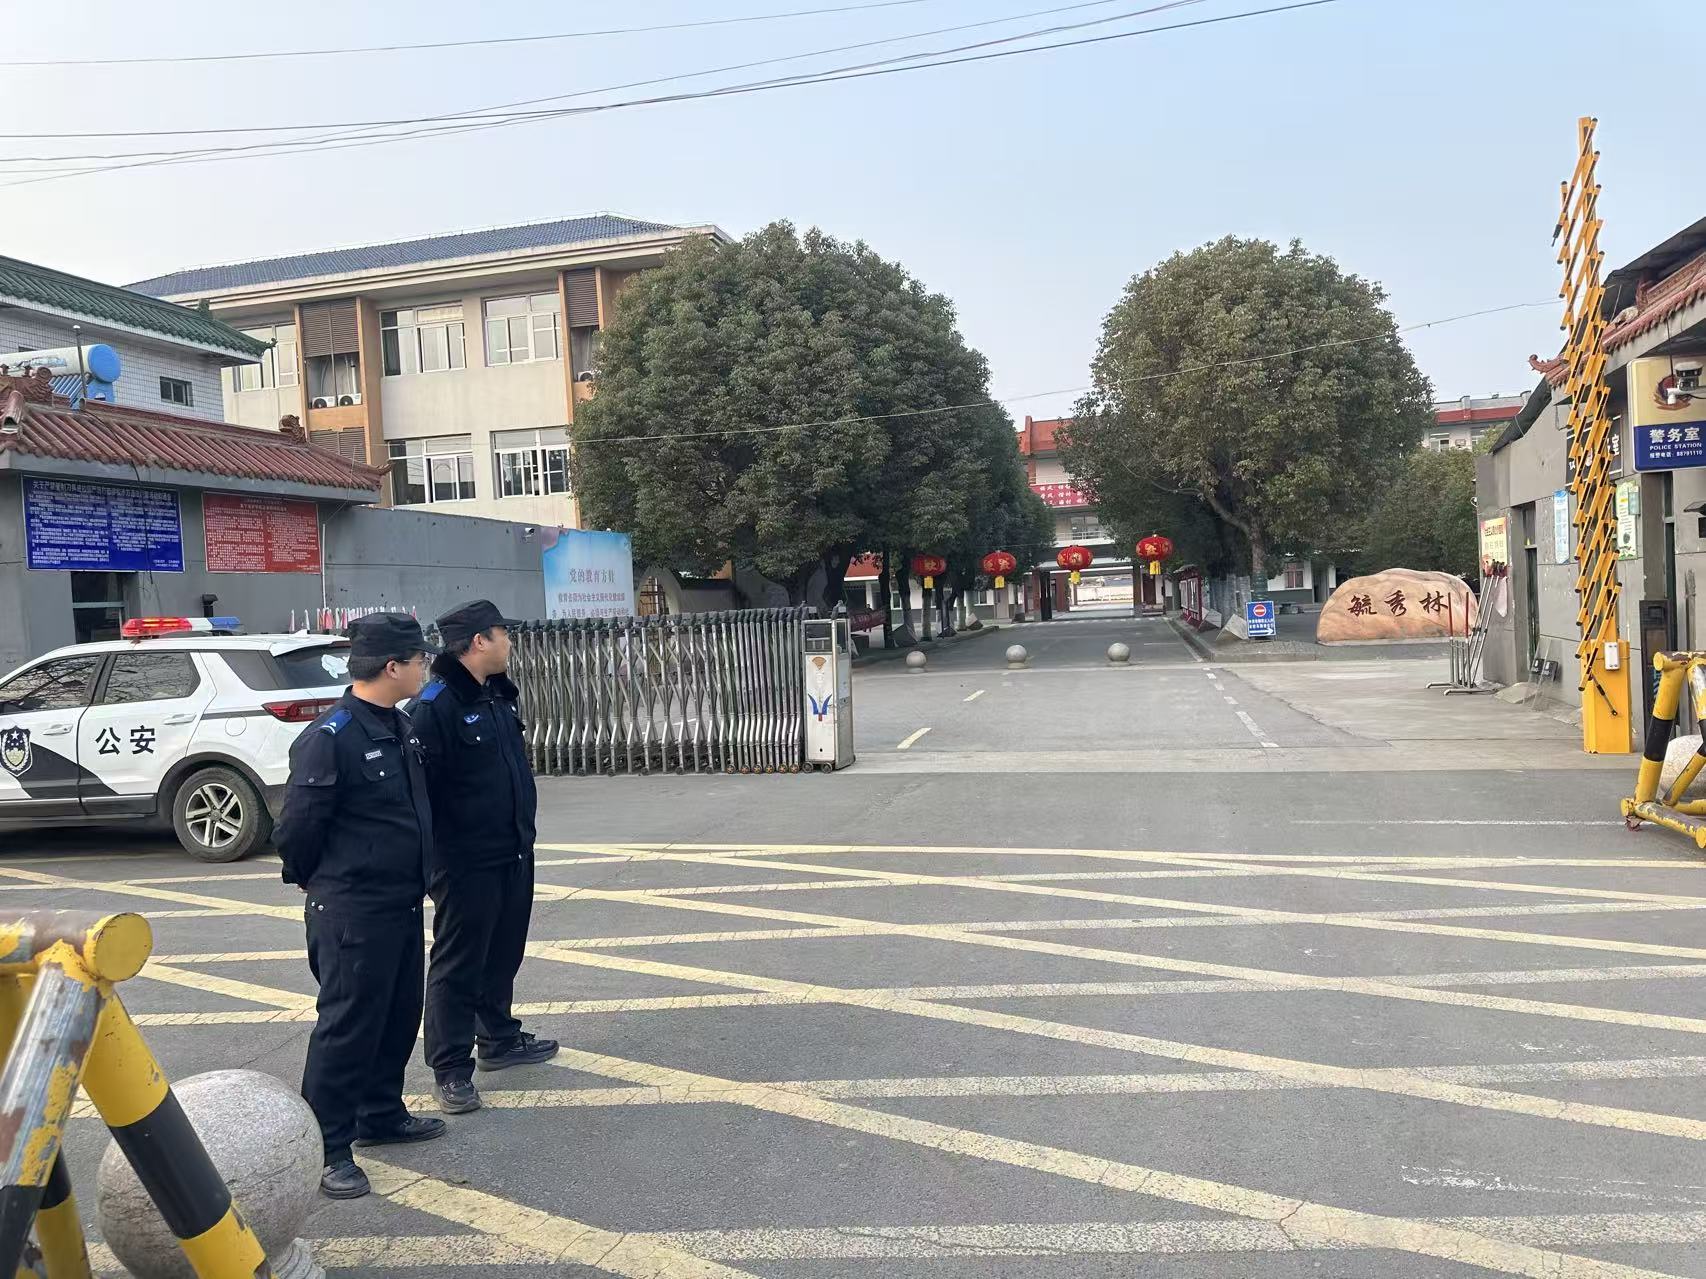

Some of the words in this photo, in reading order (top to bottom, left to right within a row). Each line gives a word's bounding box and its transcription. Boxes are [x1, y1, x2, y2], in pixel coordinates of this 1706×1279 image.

[1649, 427, 1700, 443] 警务室
[569, 567, 615, 583] 党的教育方针
[1347, 590, 1449, 617] 毓秀林
[95, 725, 156, 755] 公安
